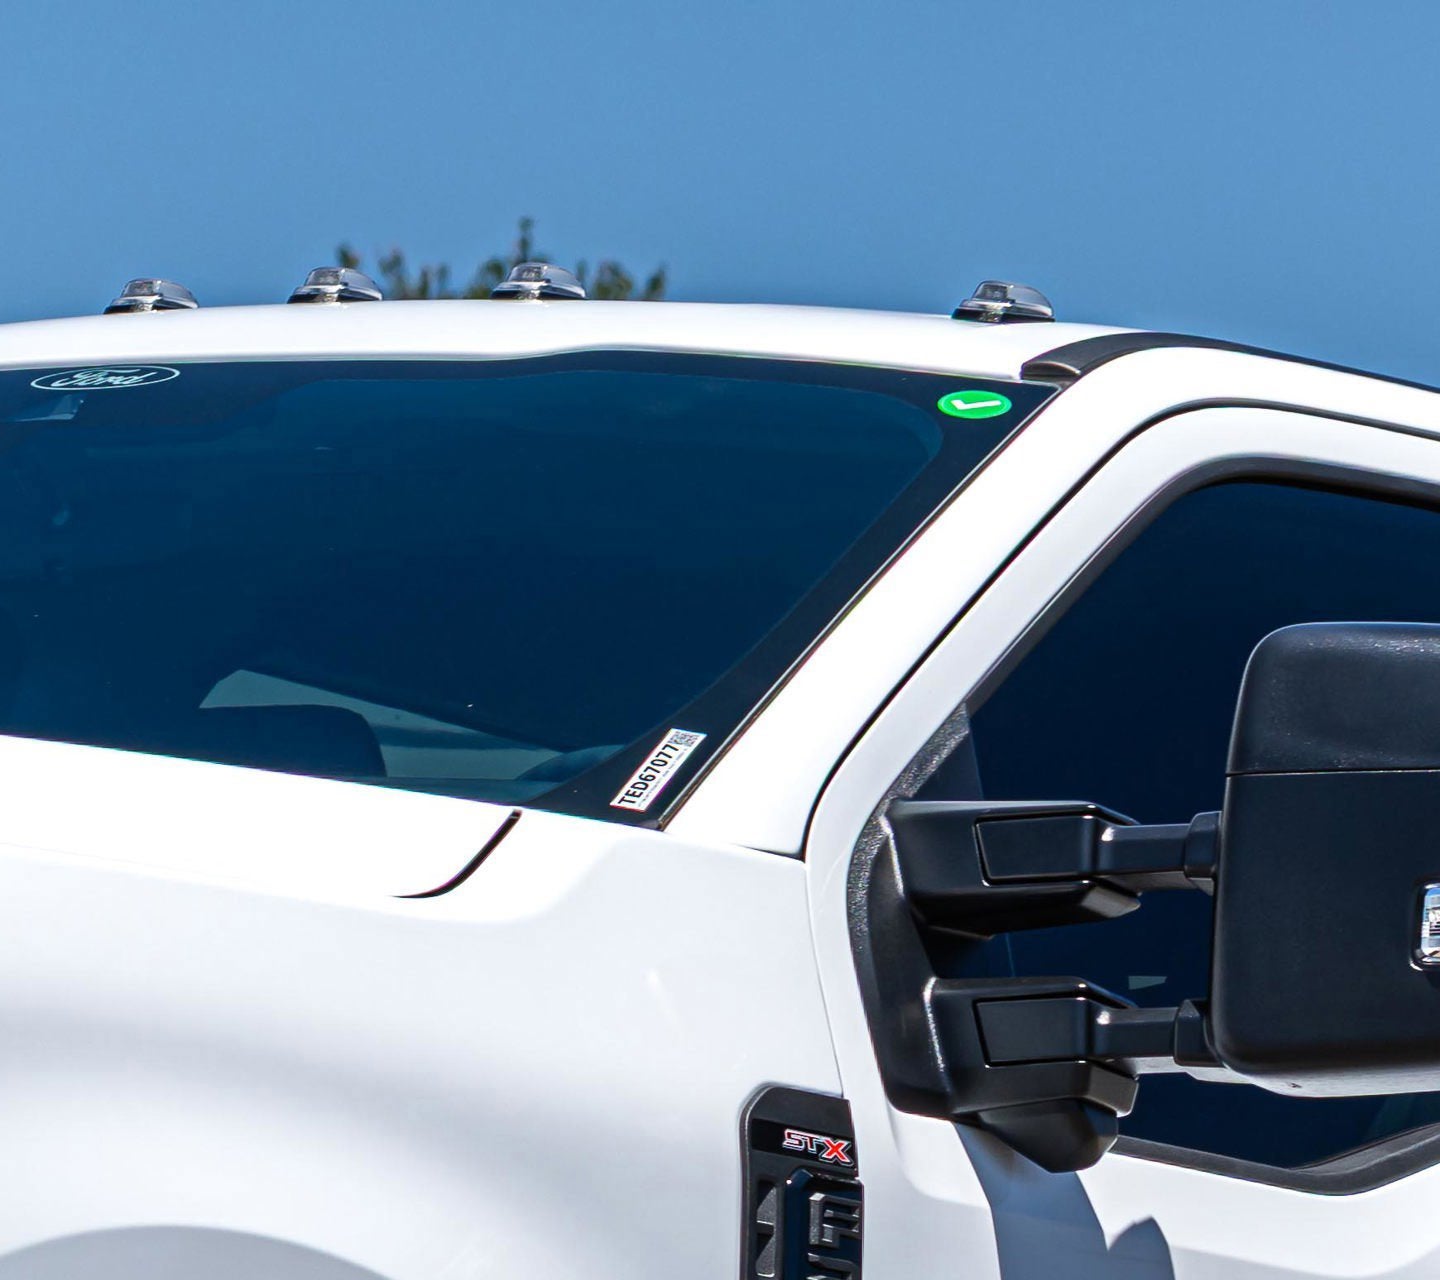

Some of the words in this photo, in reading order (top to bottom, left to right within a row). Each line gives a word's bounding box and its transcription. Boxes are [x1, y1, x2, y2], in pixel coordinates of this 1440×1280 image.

[50, 368, 158, 388] Ford
[618, 743, 680, 805] TED67077
[782, 1128, 854, 1167] STX
